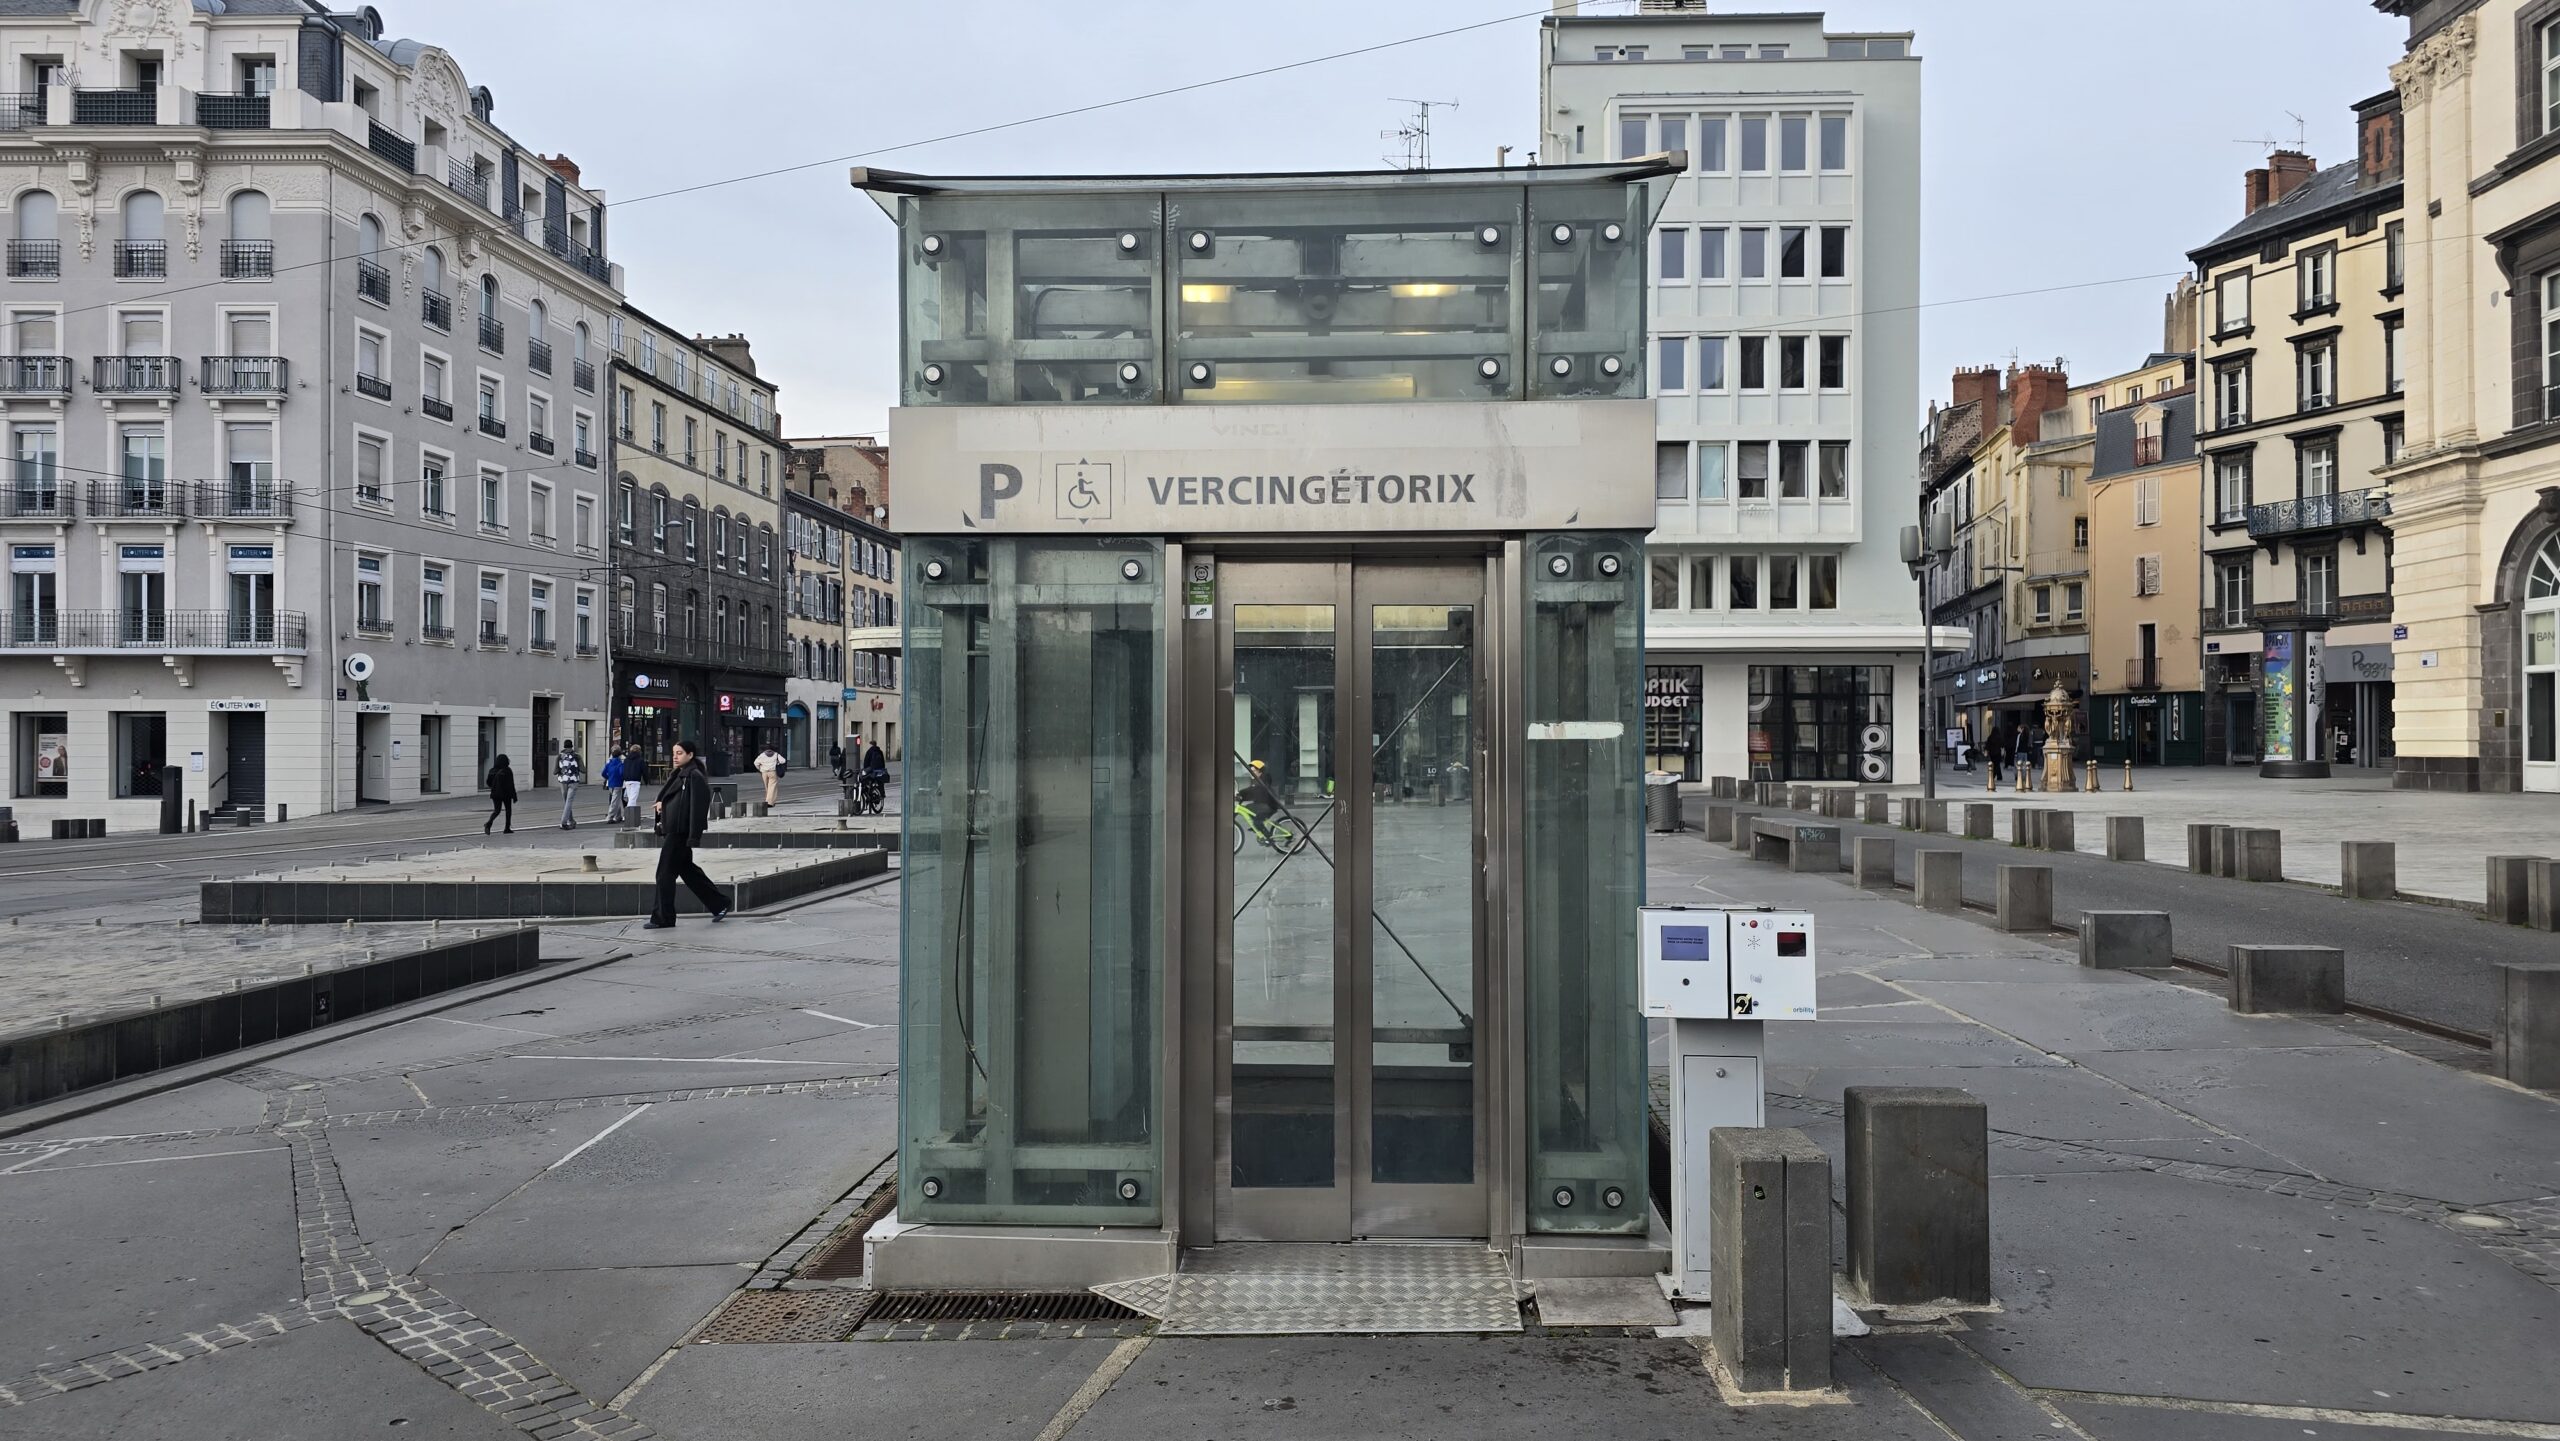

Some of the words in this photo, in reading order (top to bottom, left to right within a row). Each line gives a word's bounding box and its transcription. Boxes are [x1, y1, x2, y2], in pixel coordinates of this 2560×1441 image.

[980, 463, 1023, 519] P
[1147, 468, 1476, 506] VERCINGÉTORIX
[653, 679, 669, 688] TACOS
[1792, 1006, 1815, 1015] orbility
